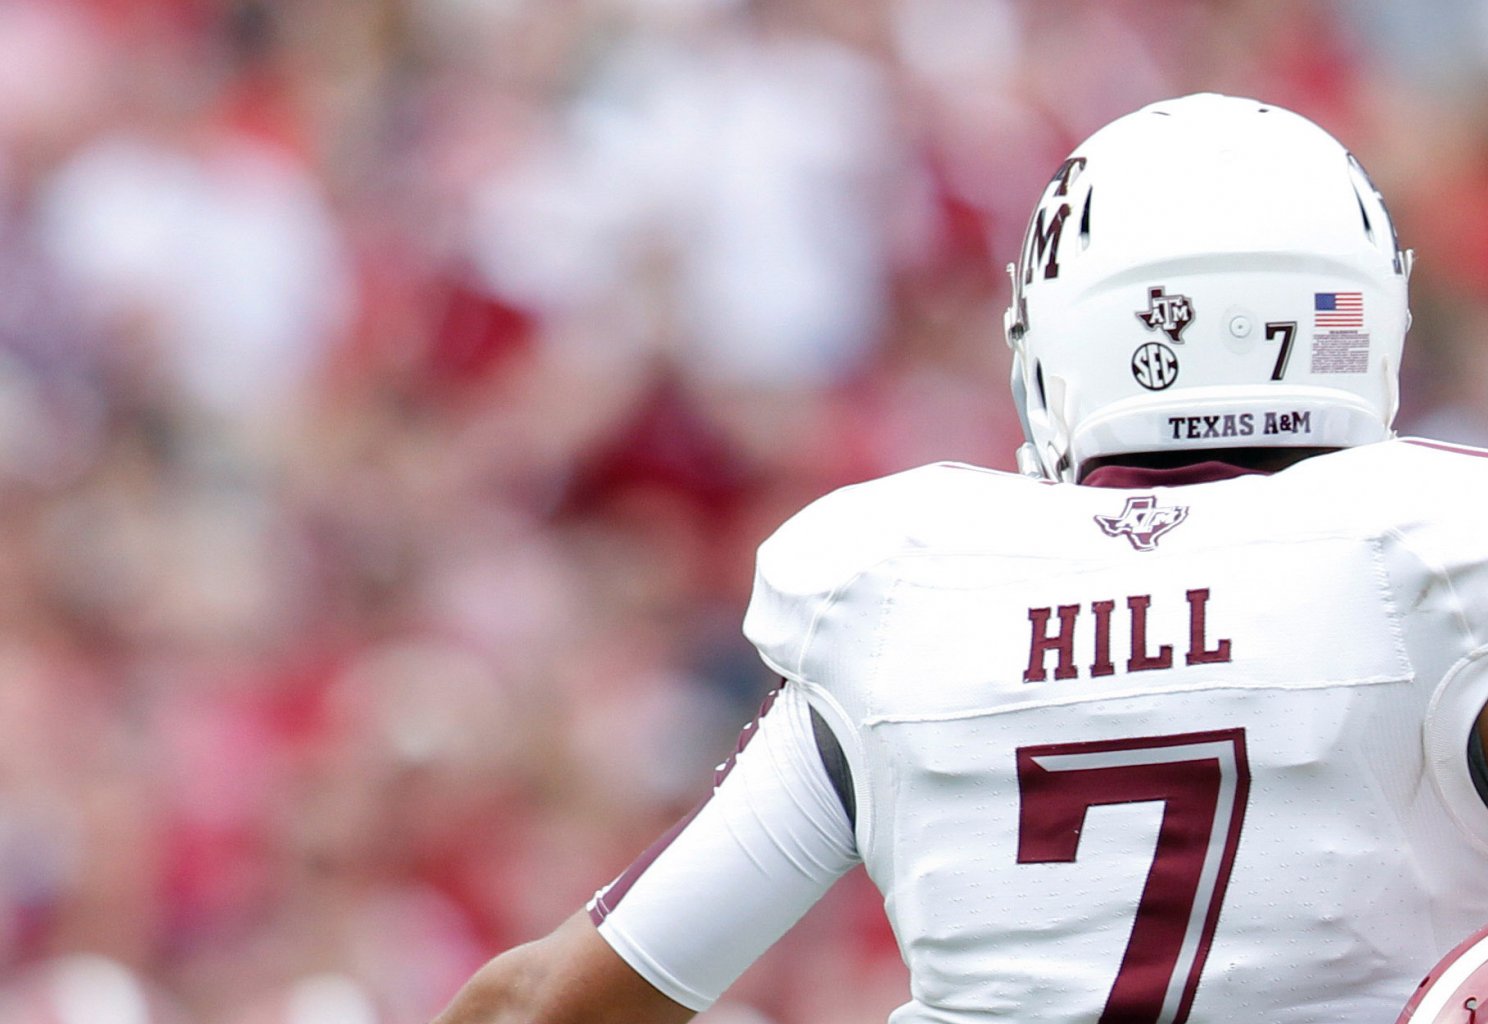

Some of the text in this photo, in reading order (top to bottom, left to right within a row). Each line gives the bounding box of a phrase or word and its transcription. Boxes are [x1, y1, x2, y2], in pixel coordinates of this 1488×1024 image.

[1132, 343, 1178, 389] SEC
[1265, 321, 1297, 380] 7
[1168, 411, 1311, 440] TEXAS A&M
[1023, 588, 1232, 683] HILL
